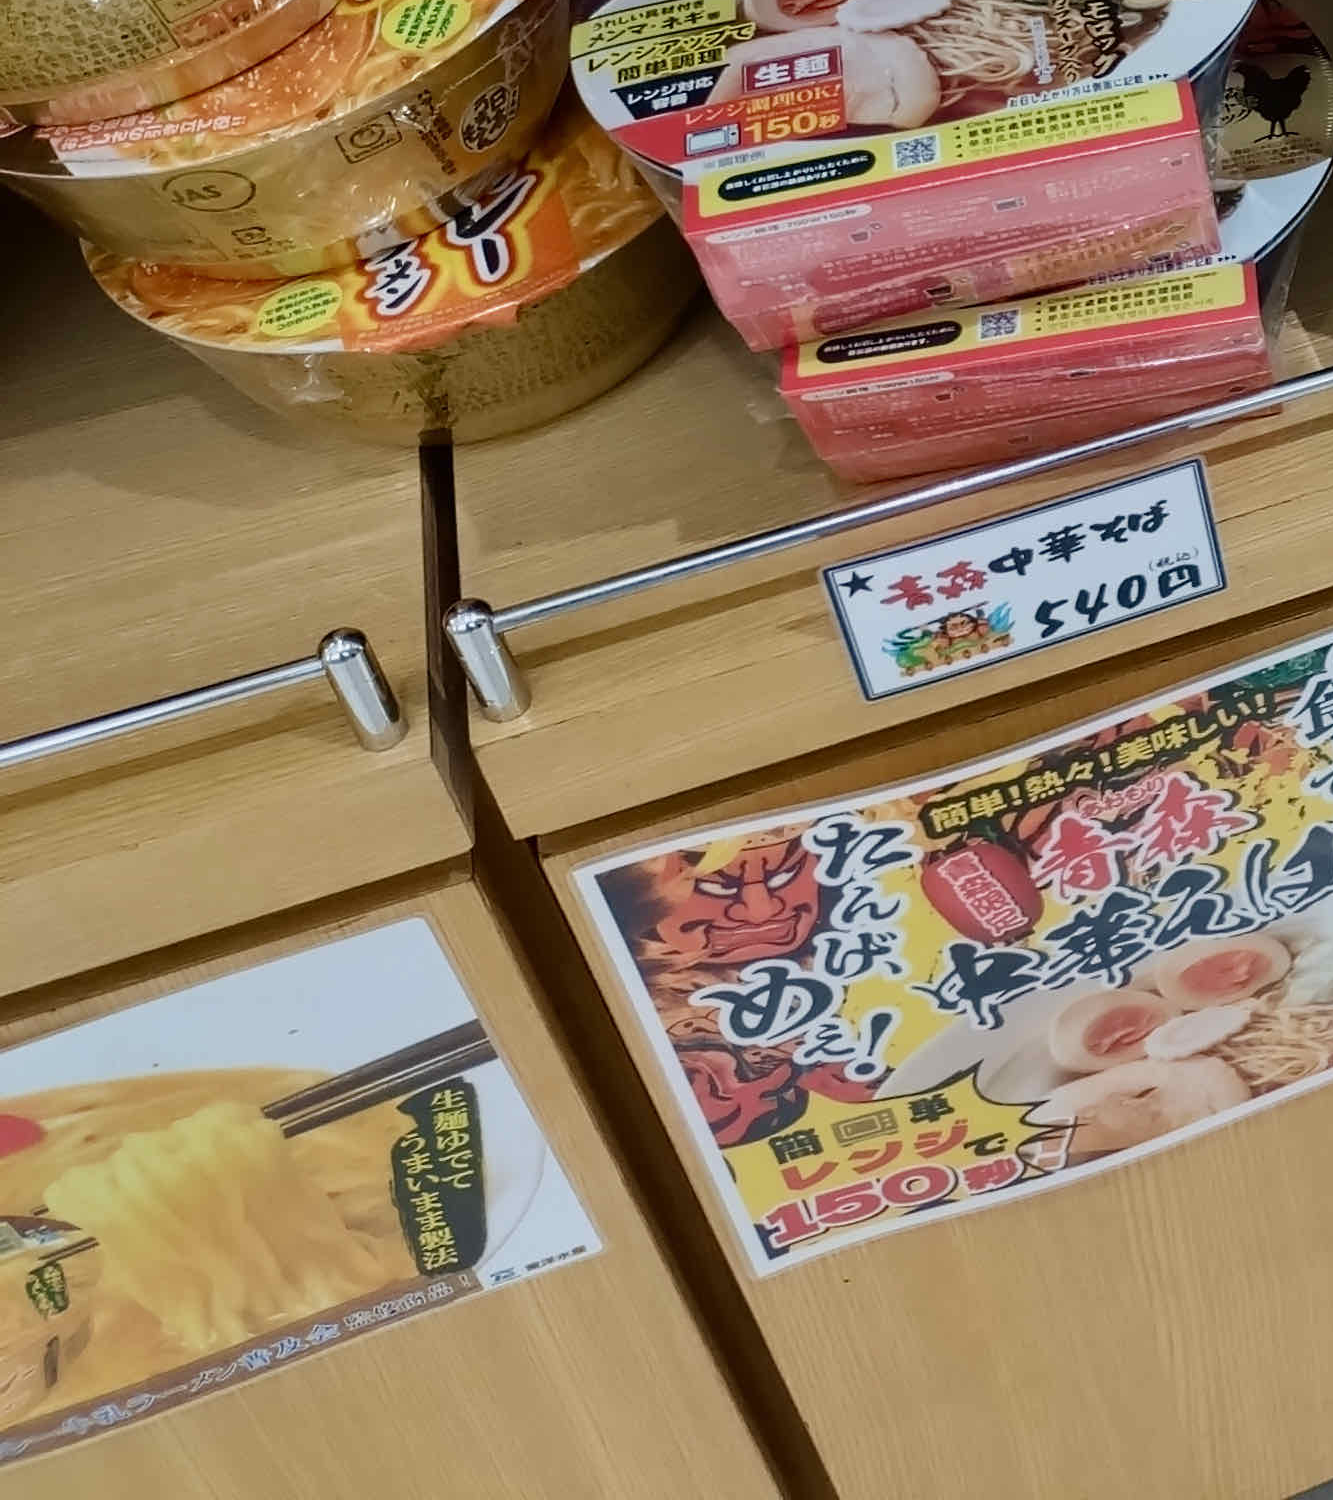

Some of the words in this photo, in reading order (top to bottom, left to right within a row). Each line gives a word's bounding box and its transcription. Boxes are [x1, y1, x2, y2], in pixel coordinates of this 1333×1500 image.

[587, 23, 754, 73] レンジアップで
[616, 48, 725, 84] 簡単調理
[754, 53, 832, 89] 生麺
[627, 75, 715, 105] レンジ対応
[684, 83, 842, 125] レンジ調理OK!
[743, 112, 842, 144] 150秒
[171, 184, 223, 207] JAS
[1034, 563, 1202, 640] 540円
[929, 695, 1273, 831] 簡単!熱々!美味しい!
[1032, 773, 1258, 902] 青森
[431, 1088, 475, 1190] 生麺ゆでて
[781, 1118, 1008, 1194] レンジで
[399, 1132, 460, 1270] うまいまま製法
